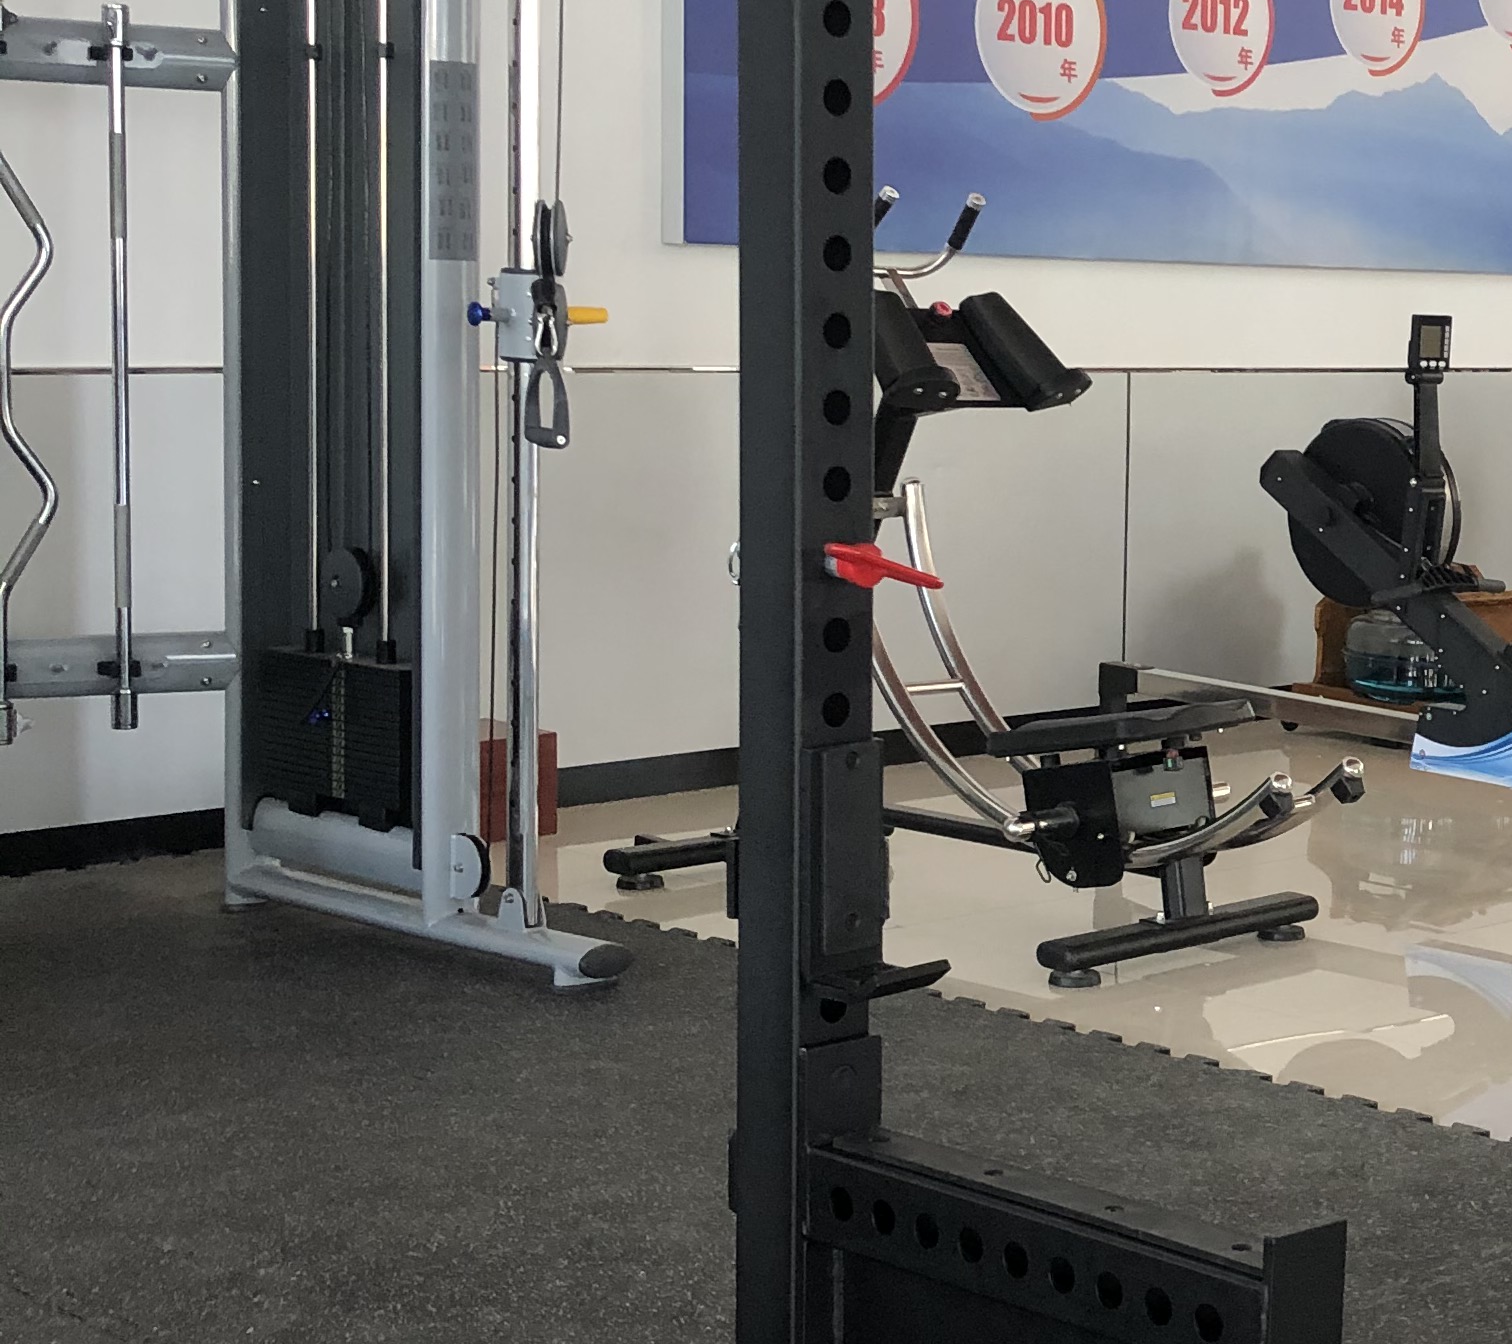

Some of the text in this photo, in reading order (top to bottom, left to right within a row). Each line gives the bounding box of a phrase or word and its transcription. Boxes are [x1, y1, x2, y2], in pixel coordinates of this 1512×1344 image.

[1391, 26, 1405, 48] 年
[1060, 58, 1078, 83] 年
[1237, 46, 1254, 71] 年
